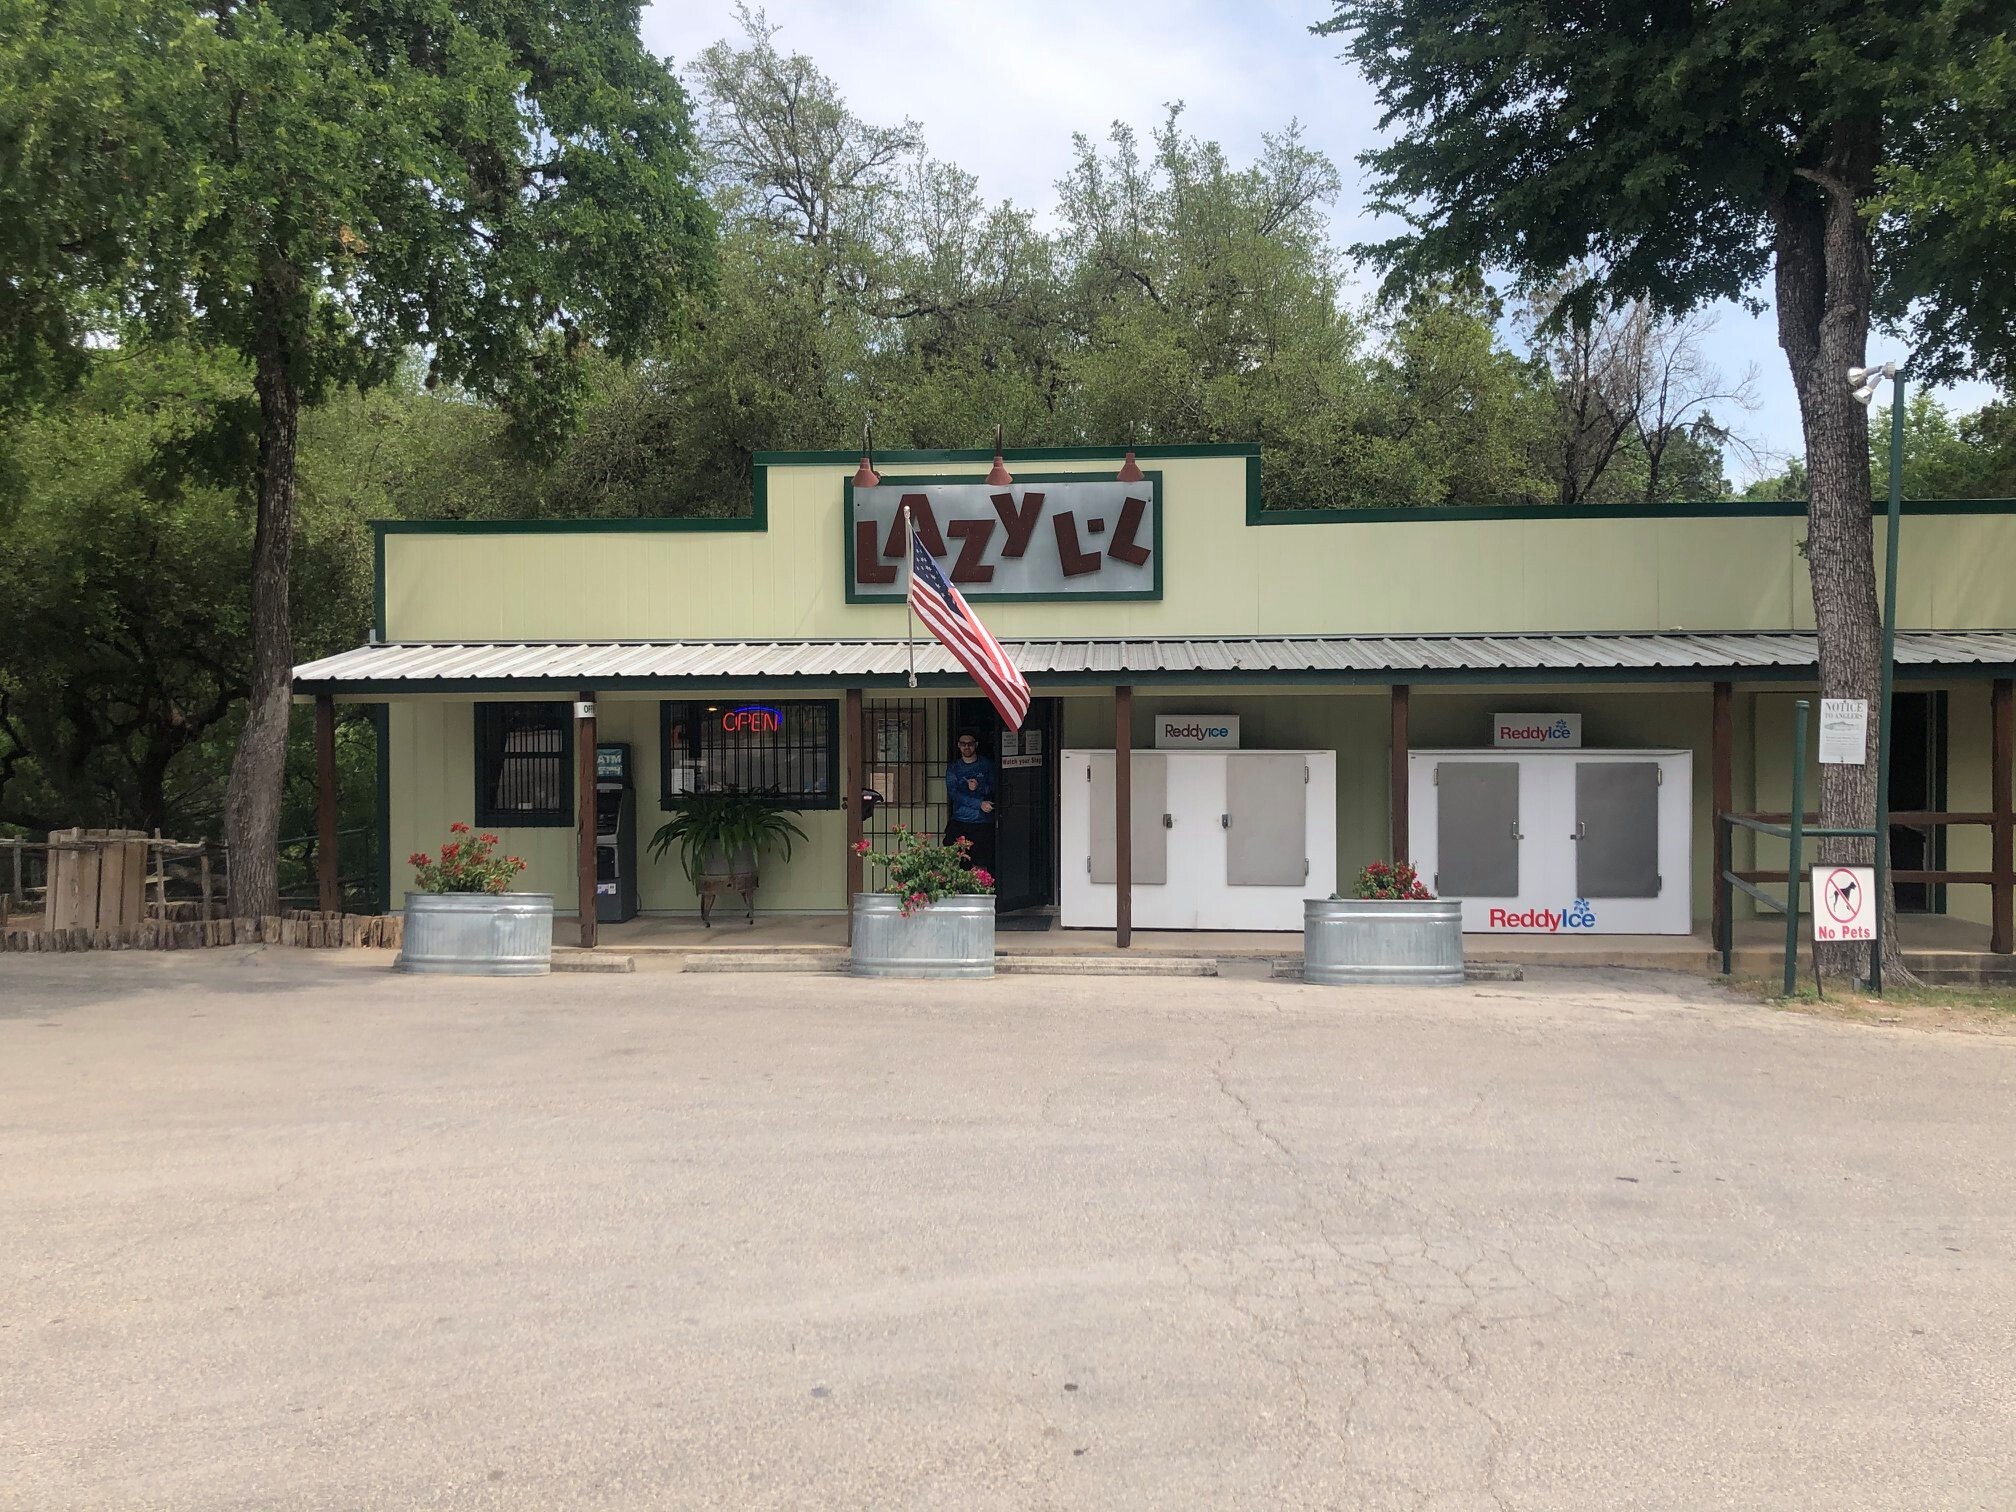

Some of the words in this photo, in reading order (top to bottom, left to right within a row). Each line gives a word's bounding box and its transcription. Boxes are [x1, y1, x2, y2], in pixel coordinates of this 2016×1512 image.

[856, 492, 1046, 584] LAZY
[1825, 702, 1863, 712] NOTICE
[722, 712, 779, 732] OPEN
[597, 755, 622, 764] ATM
[1818, 926, 1835, 940] No
[1841, 925, 1871, 939] Pets
